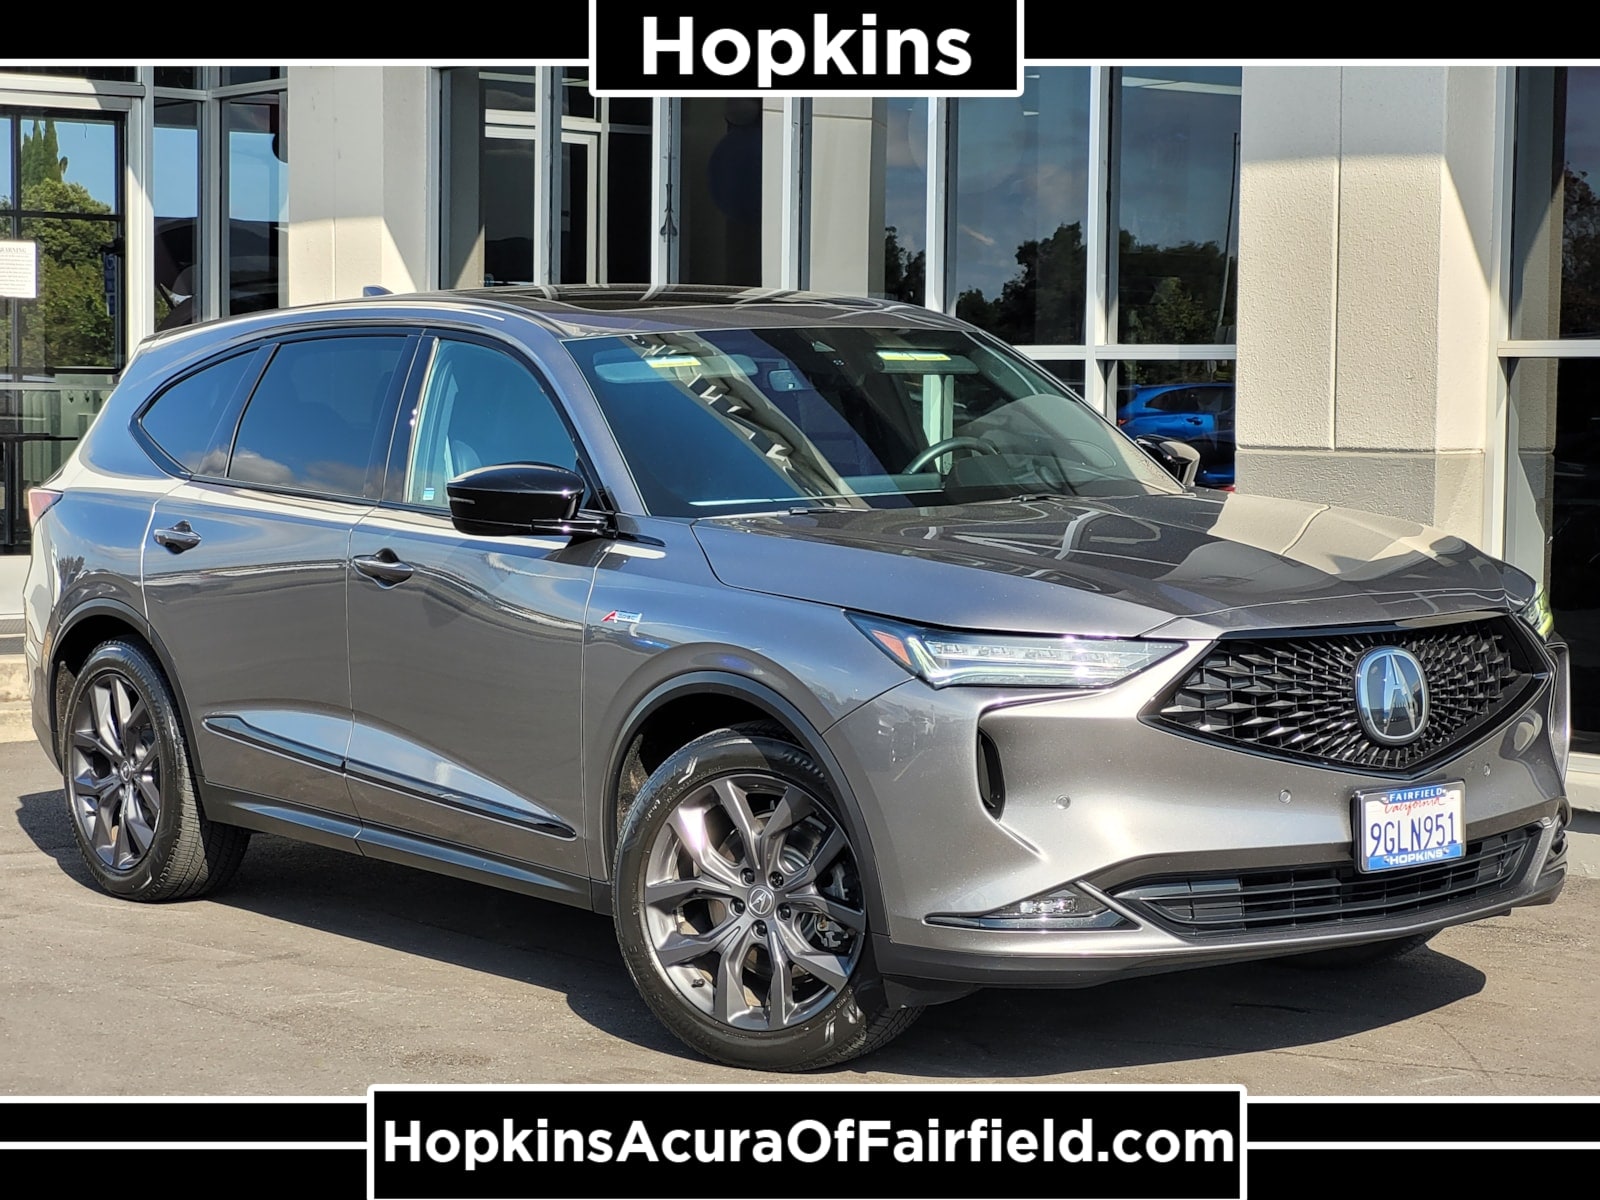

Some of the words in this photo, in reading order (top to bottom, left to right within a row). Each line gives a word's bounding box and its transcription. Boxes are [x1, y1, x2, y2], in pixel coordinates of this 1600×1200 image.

[1390, 788, 1442, 801] FAIRFIELD
[1370, 812, 1457, 857] 9GLN951
[1390, 850, 1443, 865] HOPKINS
